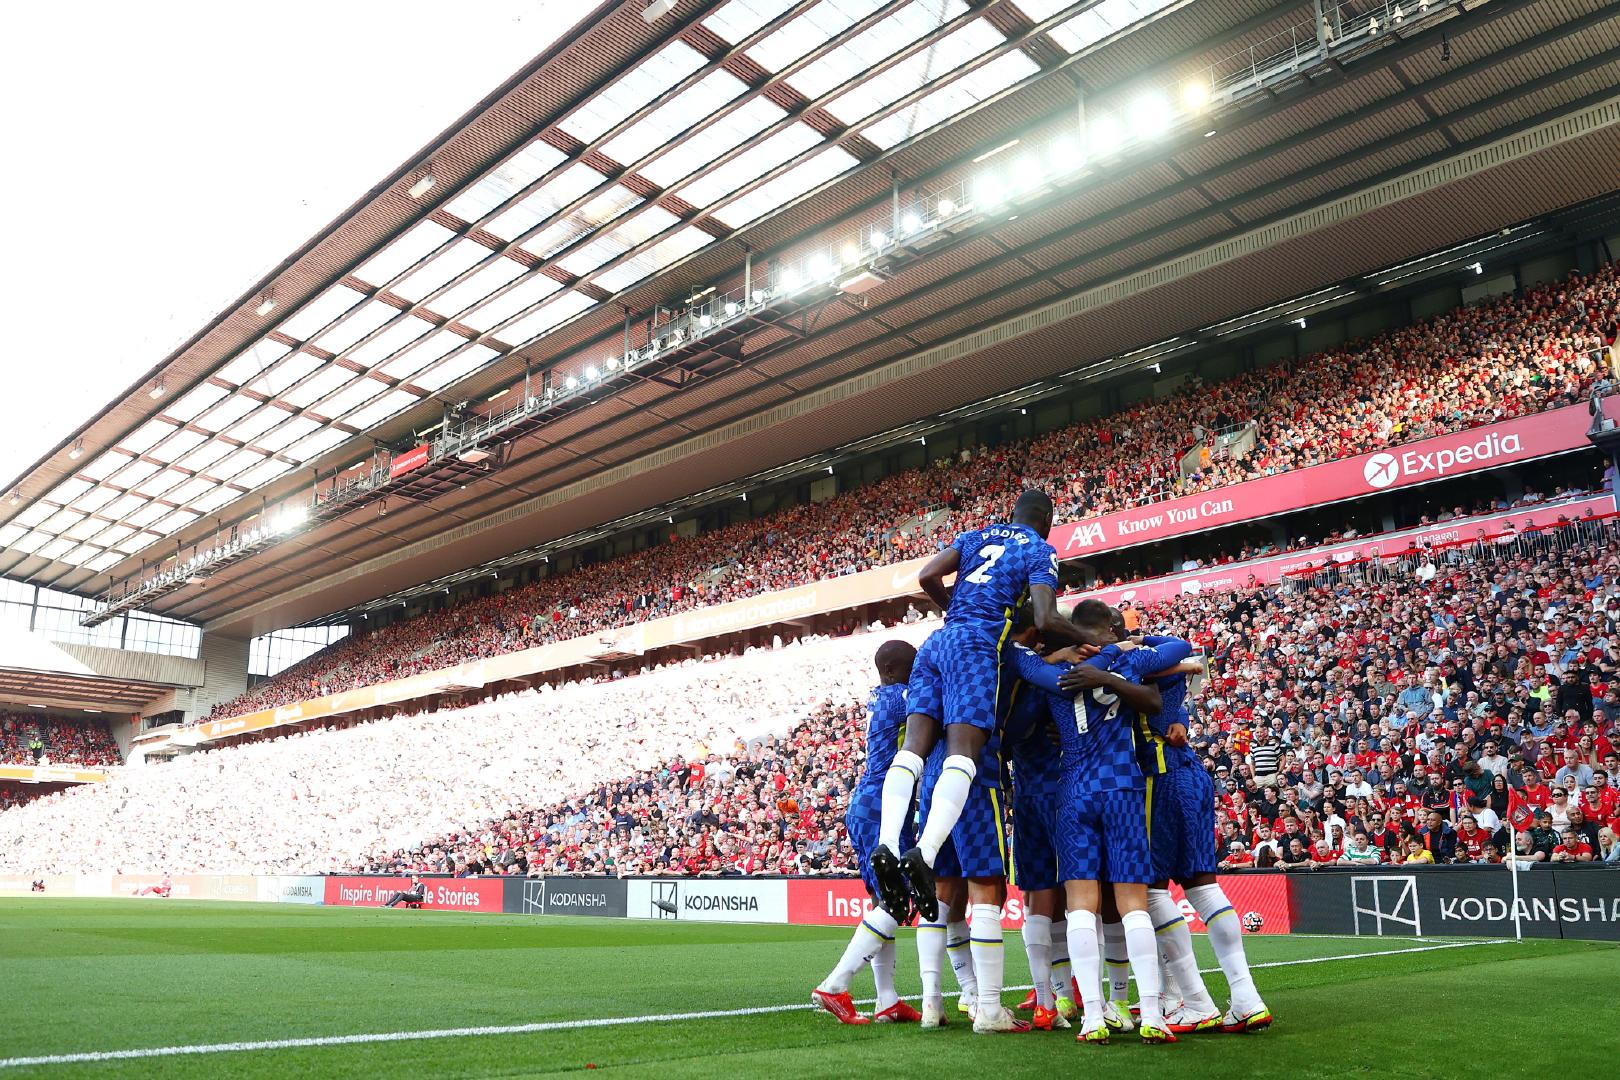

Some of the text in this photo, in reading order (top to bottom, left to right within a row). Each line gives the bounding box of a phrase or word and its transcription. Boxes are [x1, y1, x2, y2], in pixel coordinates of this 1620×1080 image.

[1402, 432, 1521, 476] Expedia
[1117, 499, 1234, 536] Know You Can
[1065, 522, 1106, 551] AXA
[964, 544, 1006, 584] 2
[1202, 578, 1233, 588] bargains
[340, 883, 372, 905] Inspire
[437, 885, 480, 906] Stories
[550, 893, 607, 908] KODANSHA
[684, 895, 759, 911] KODANSHA
